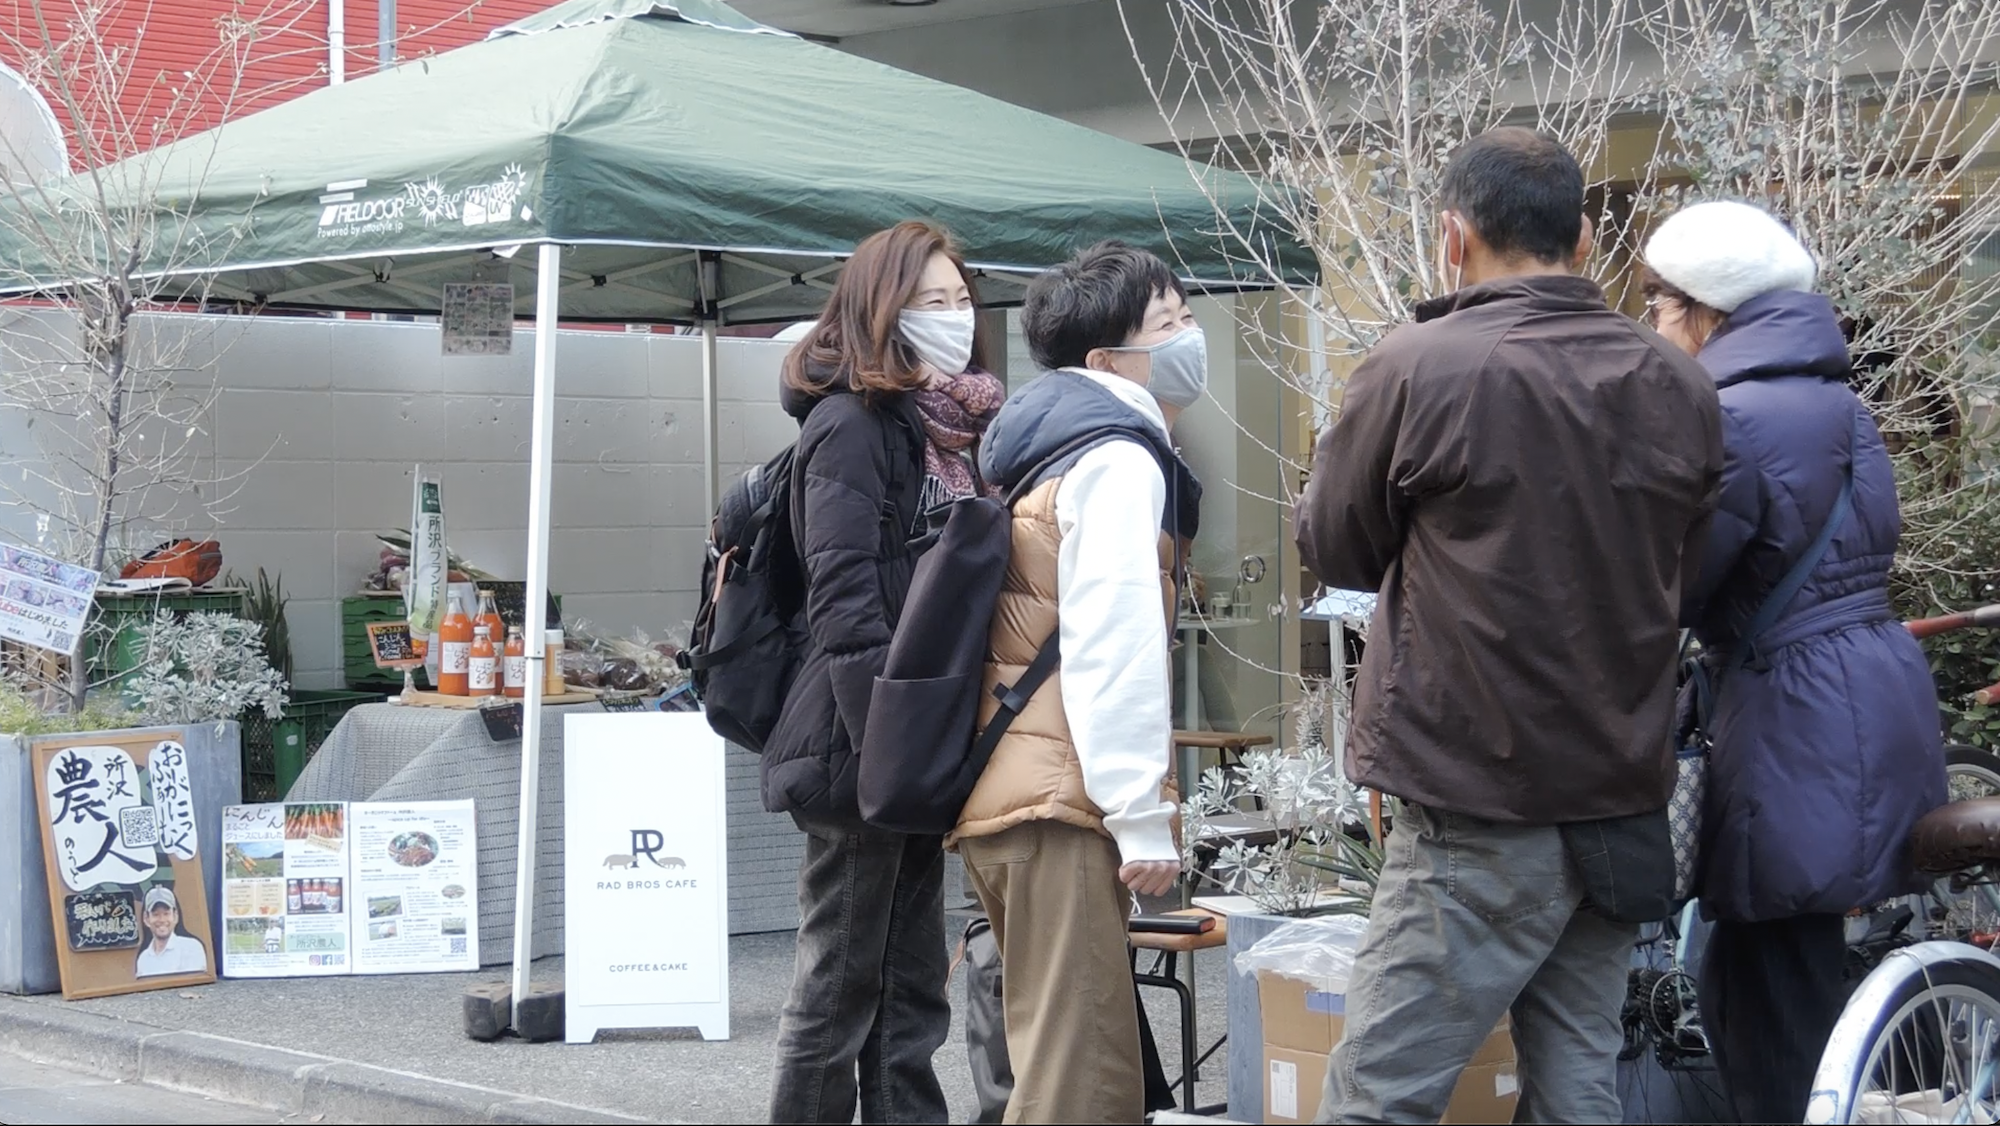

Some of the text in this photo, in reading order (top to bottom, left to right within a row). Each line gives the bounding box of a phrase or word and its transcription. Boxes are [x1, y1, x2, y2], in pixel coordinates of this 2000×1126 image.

[337, 198, 404, 224] FIELDOOR
[317, 224, 349, 238] Powered
[350, 223, 361, 238] by
[104, 754, 133, 800] 所沢
[52, 750, 156, 873] 農人
[225, 807, 285, 829] にんじん
[597, 879, 697, 890] RAD BROS CAFE
